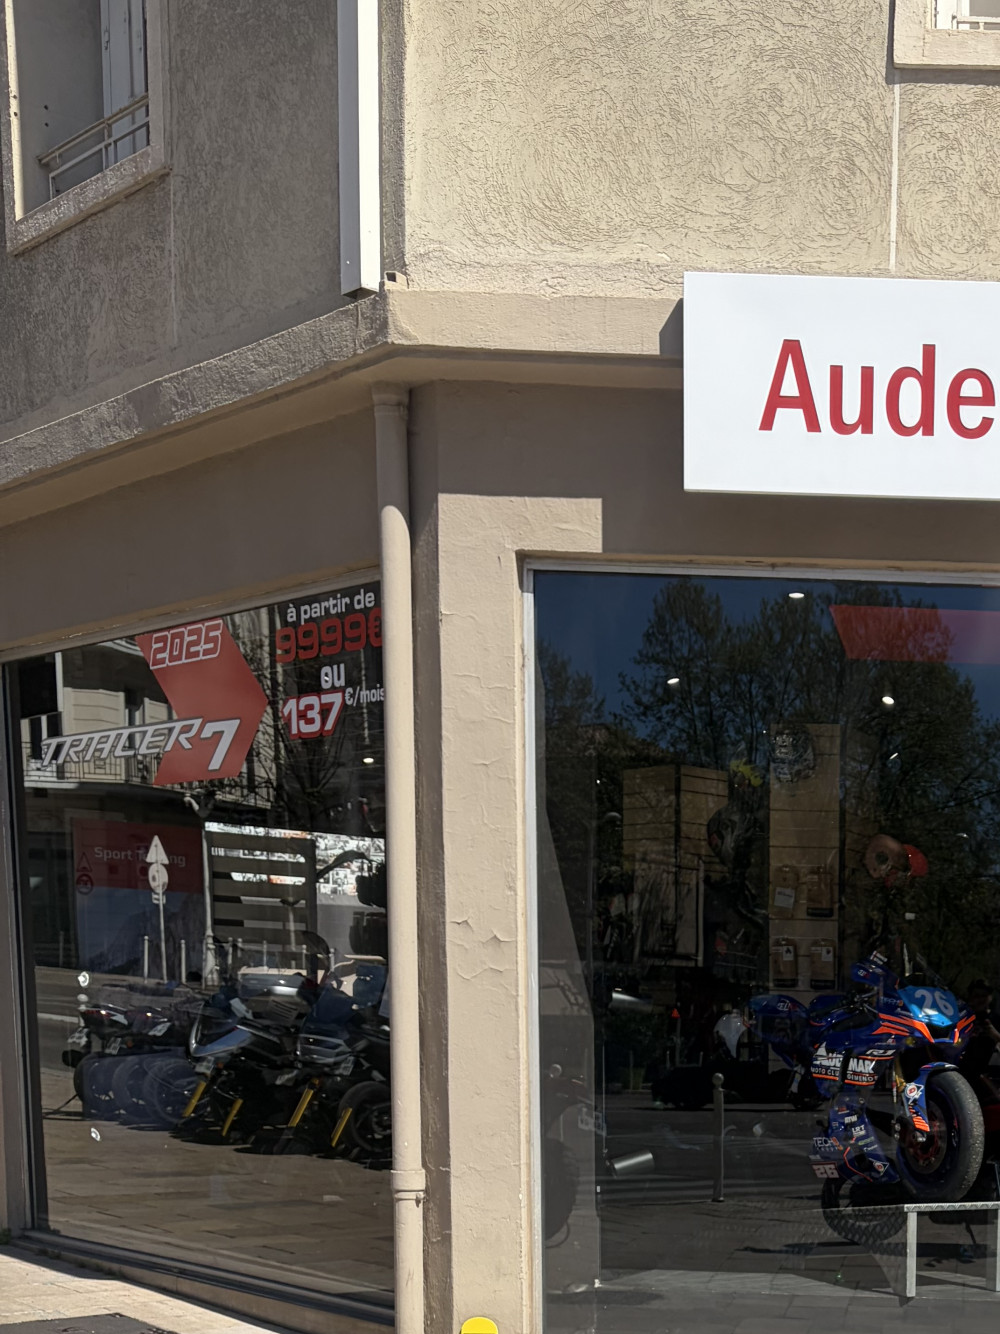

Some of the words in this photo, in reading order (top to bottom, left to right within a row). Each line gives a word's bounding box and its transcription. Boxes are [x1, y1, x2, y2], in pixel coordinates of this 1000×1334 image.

[287, 603, 297, 622] à
[300, 594, 350, 625] partir
[354, 588, 375, 609] de
[150, 620, 223, 670] 2025
[275, 607, 383, 663] 9999€
[320, 663, 345, 689] ou
[282, 691, 343, 736] 137
[41, 718, 203, 767] TRACER
[200, 718, 241, 771] 7
[94, 847, 132, 861] Sport
[914, 989, 954, 1016] 26
